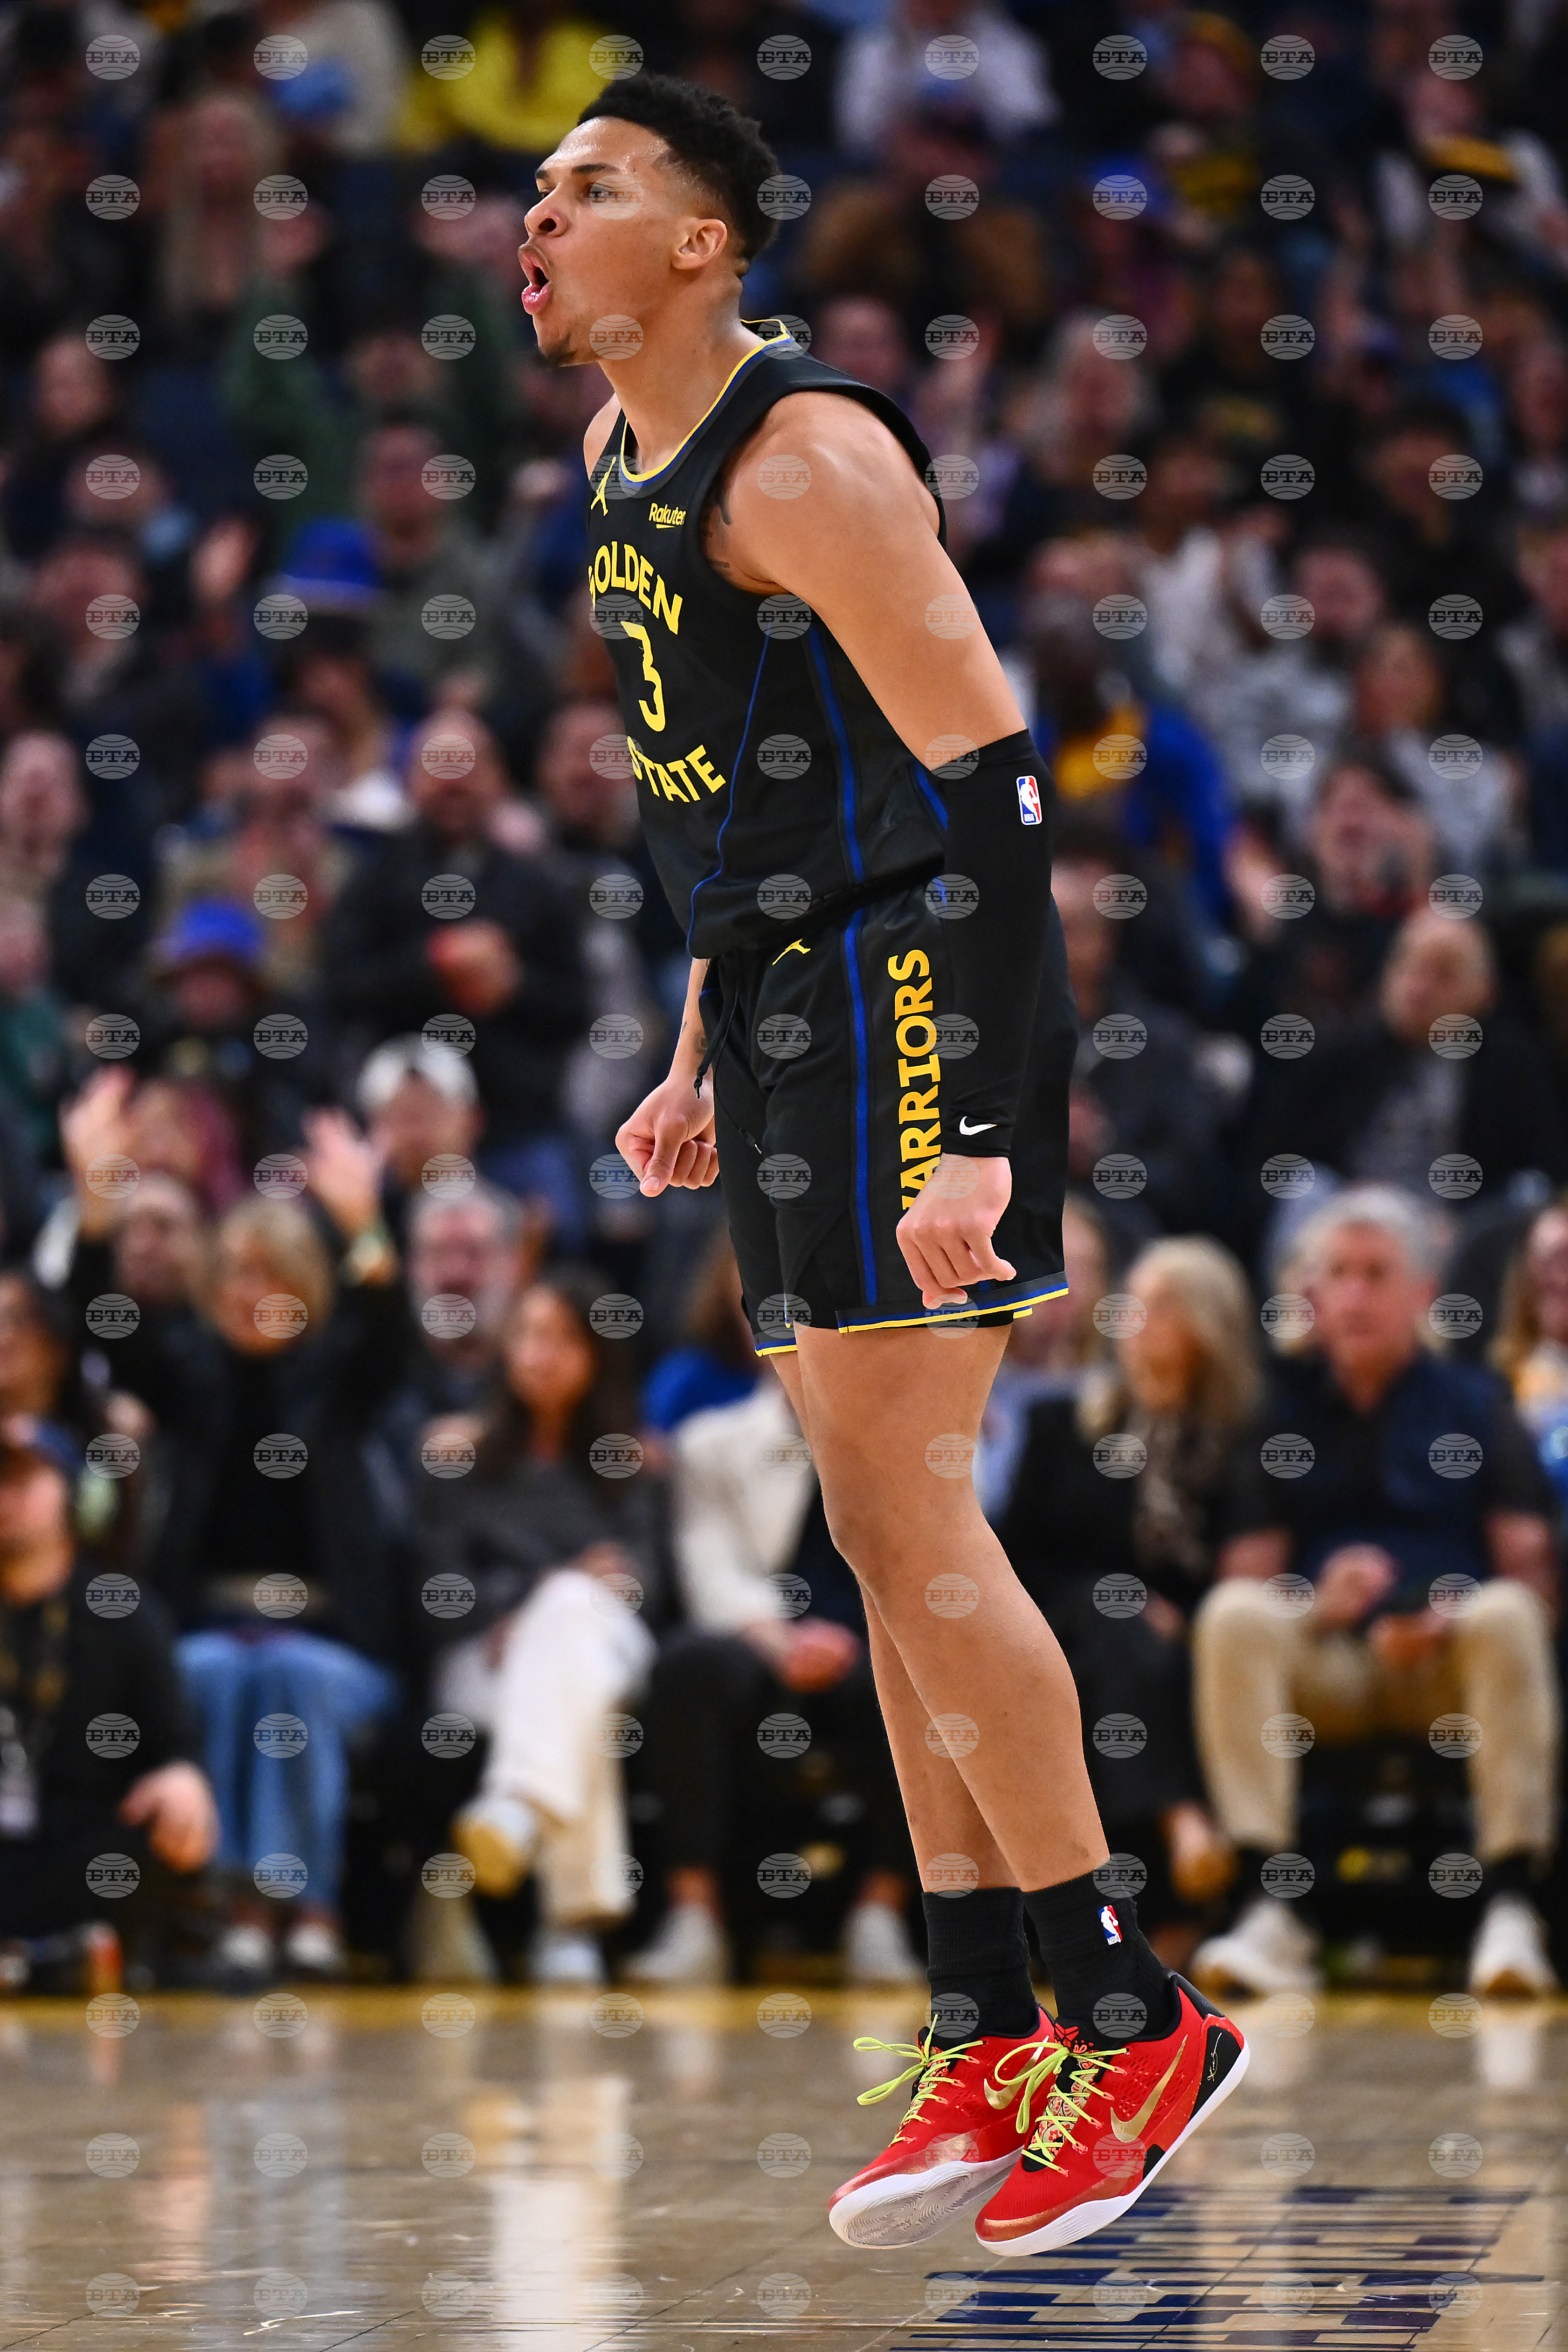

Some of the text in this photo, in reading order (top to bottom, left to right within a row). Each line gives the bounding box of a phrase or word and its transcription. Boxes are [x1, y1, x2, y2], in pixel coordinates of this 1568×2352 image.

[620, 621, 666, 732] 3
[627, 735, 726, 803] STATE
[887, 949, 941, 1211] ARRIORS
